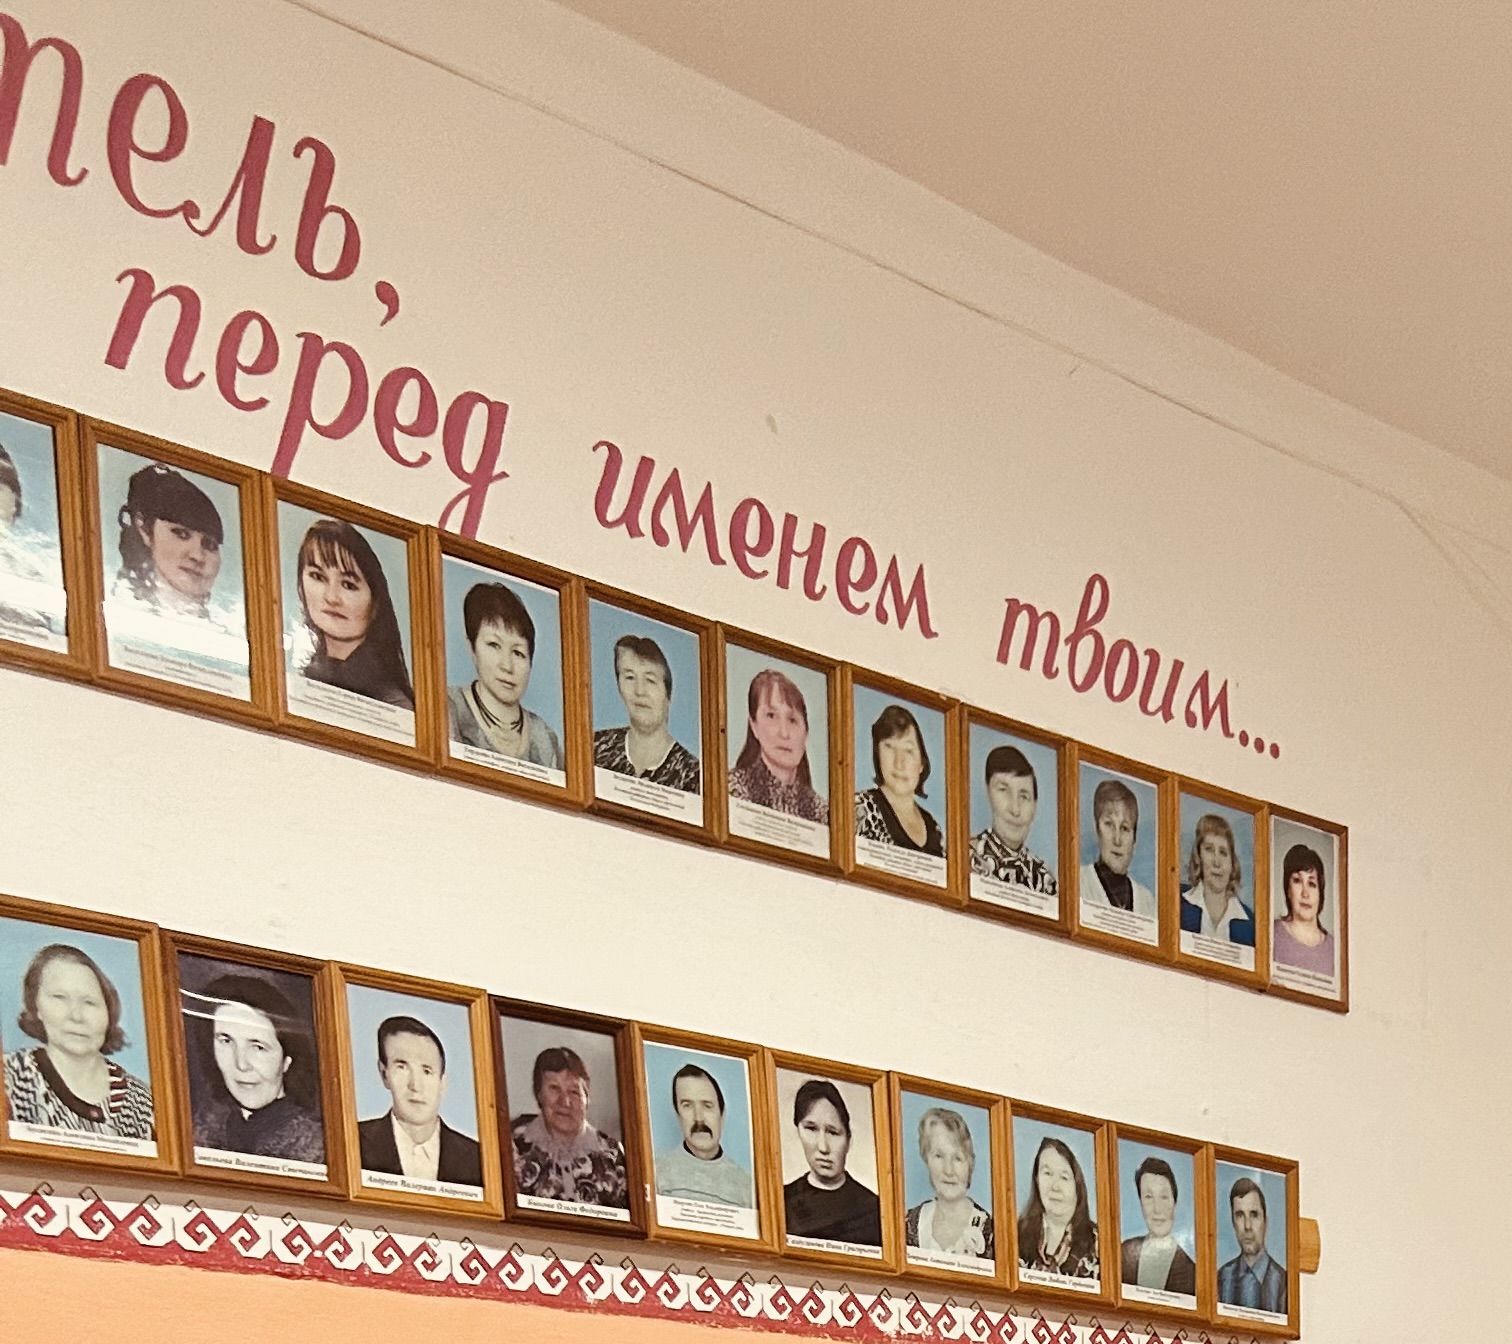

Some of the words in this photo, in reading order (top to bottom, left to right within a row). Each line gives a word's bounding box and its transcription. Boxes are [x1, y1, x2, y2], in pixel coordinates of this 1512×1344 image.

[103, 268, 511, 536] перед
[592, 437, 940, 641] именем
[996, 573, 1282, 759] твоим...
